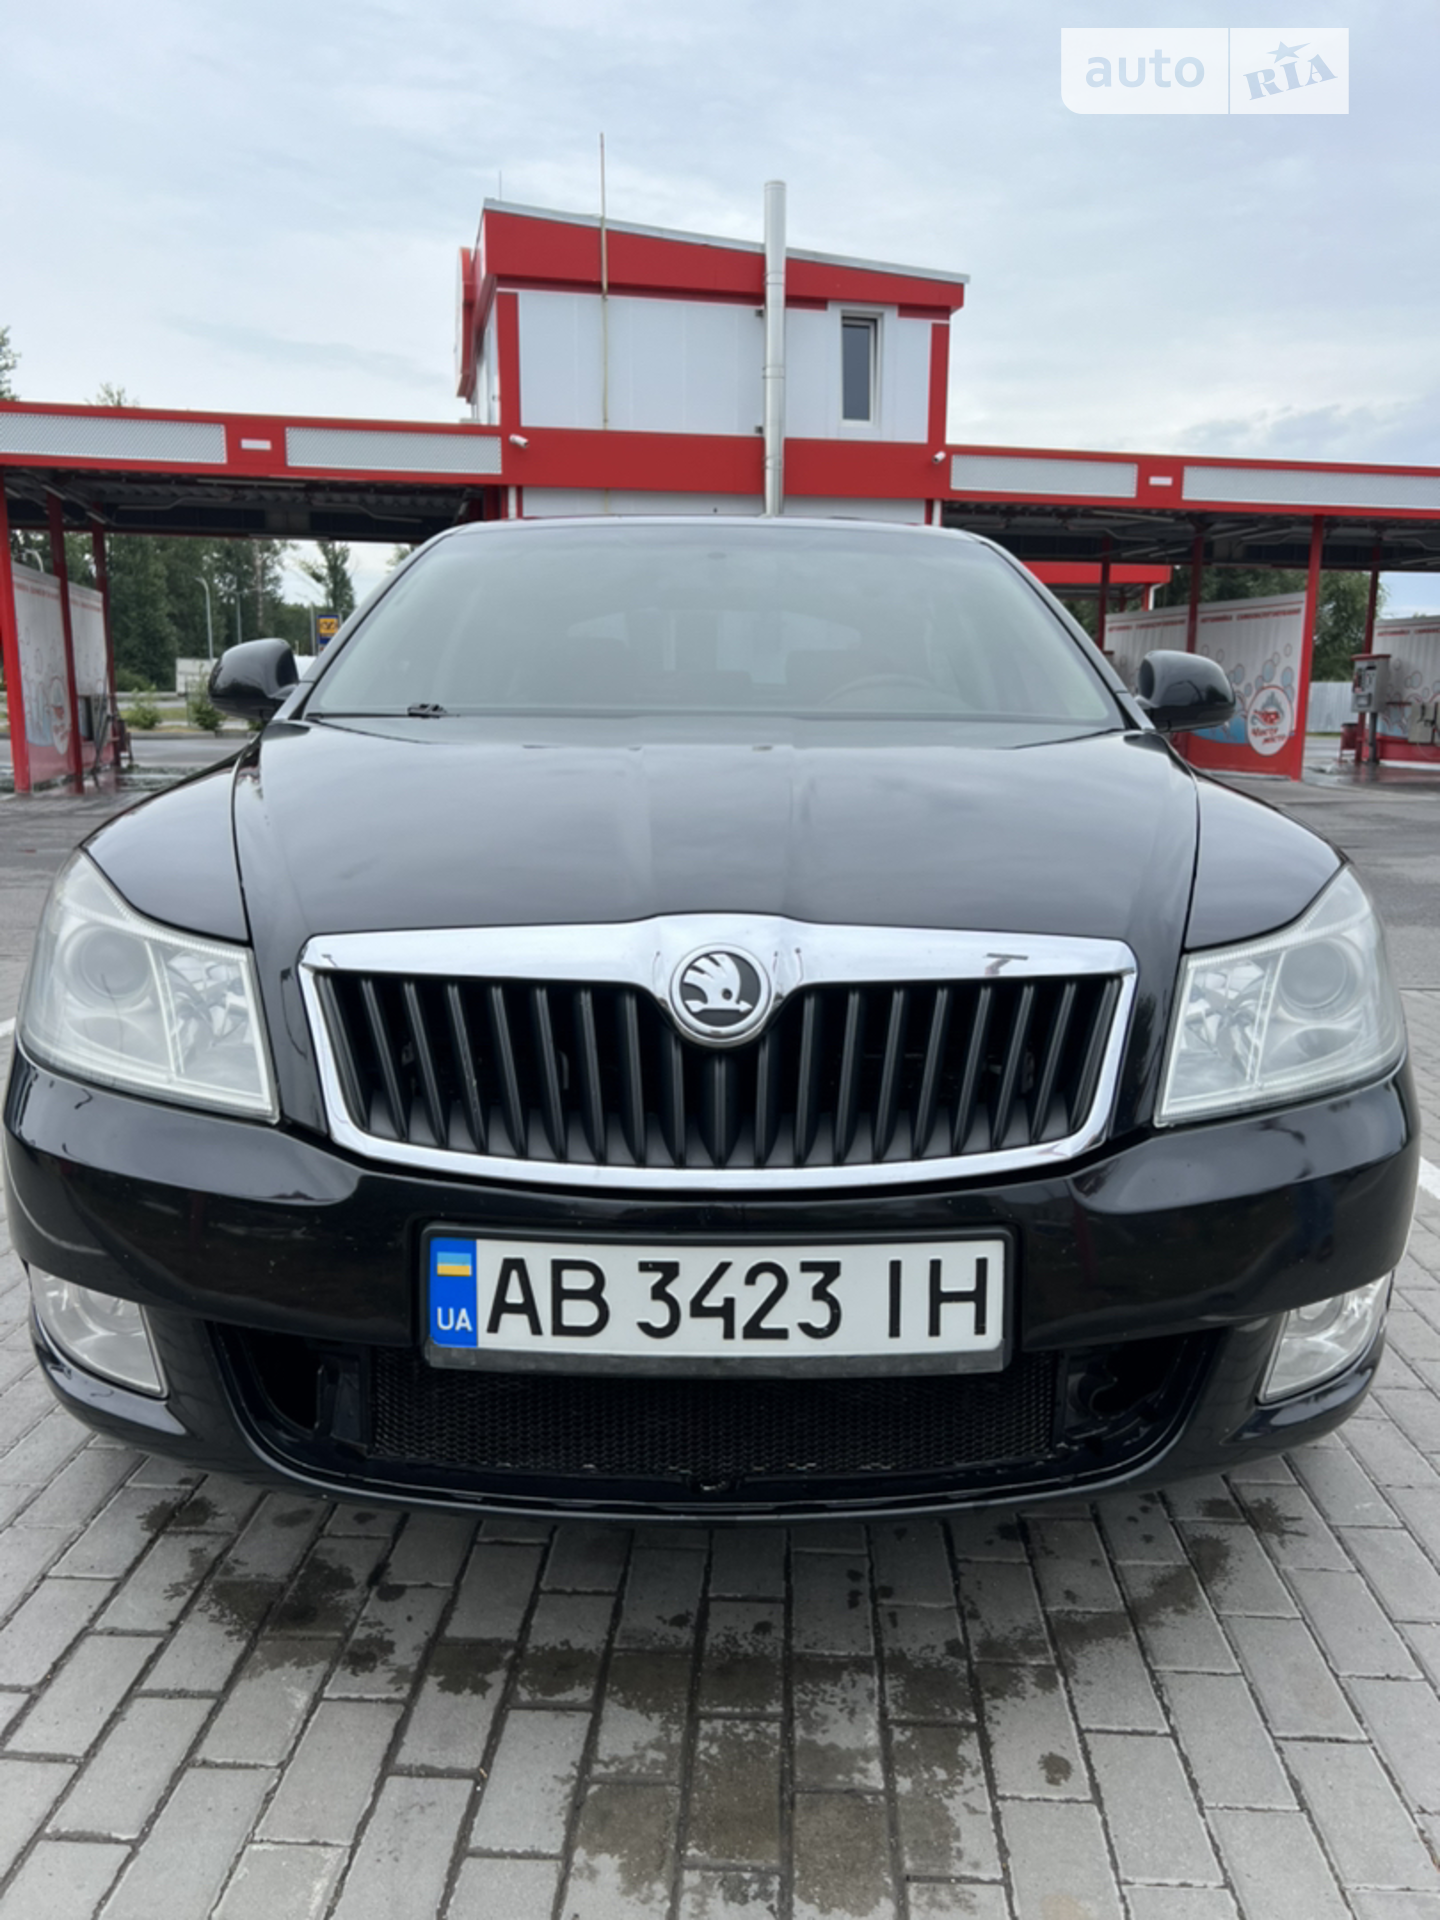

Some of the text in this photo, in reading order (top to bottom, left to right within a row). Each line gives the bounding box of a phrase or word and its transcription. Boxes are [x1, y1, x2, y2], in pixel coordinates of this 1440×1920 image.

[437, 1307, 473, 1332] UA
[486, 1257, 610, 1337] AB
[636, 1260, 842, 1340] 3423
